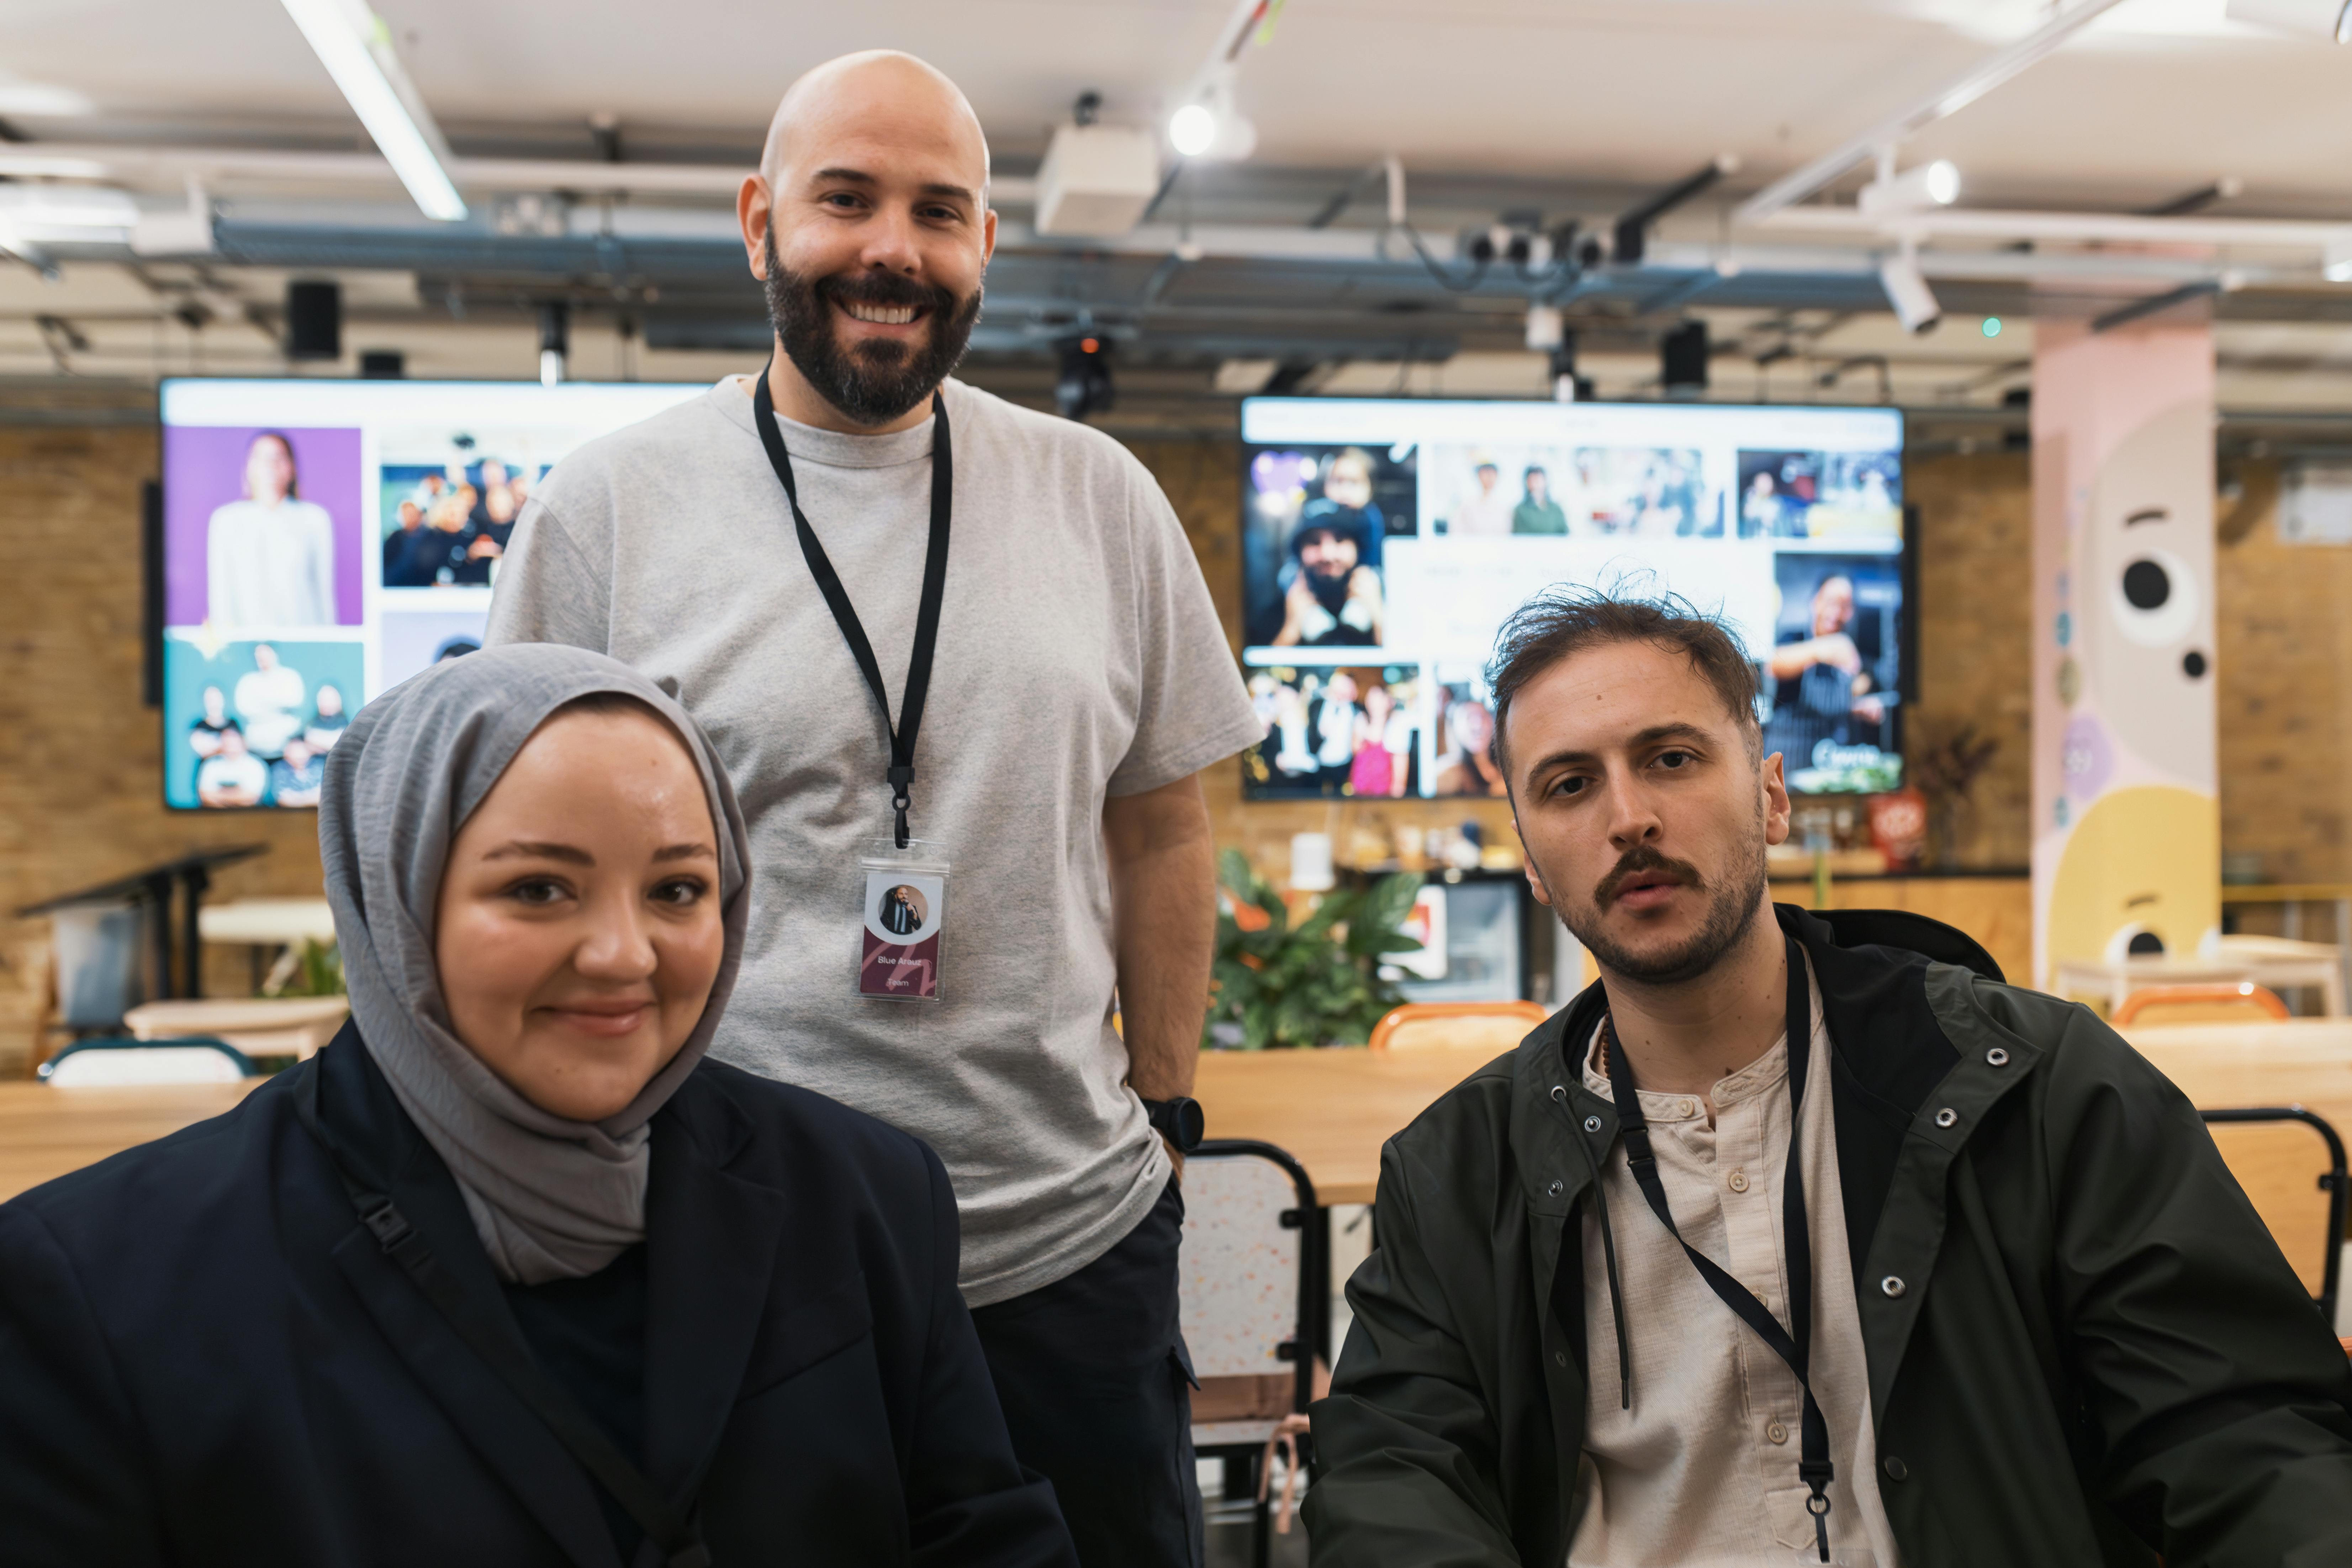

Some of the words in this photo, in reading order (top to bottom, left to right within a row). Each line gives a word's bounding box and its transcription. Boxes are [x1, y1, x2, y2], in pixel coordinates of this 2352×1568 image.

[878, 956, 896, 965] Blue
[898, 957, 921, 966] Arauz
[887, 978, 909, 987] Team
